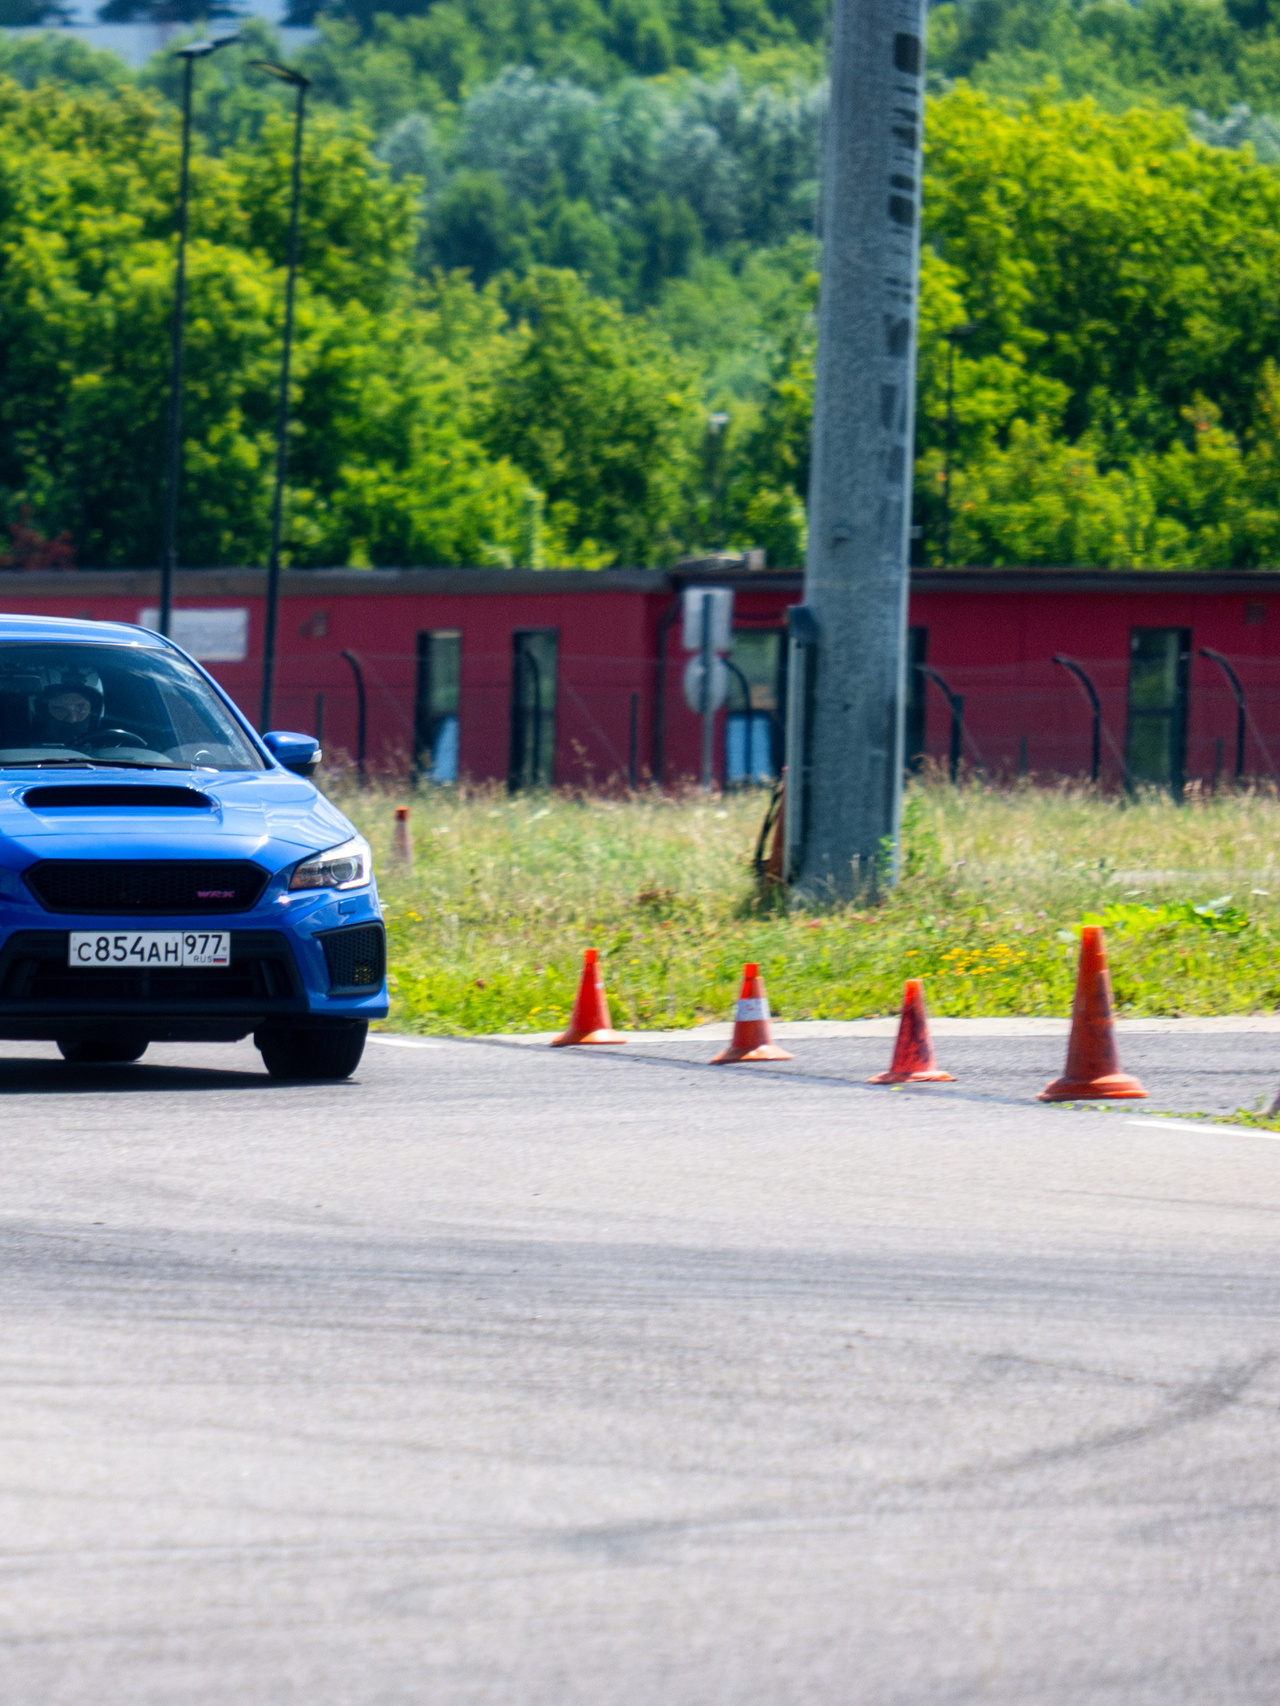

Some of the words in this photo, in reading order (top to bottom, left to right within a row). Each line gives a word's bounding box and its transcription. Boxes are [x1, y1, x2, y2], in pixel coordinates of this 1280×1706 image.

[77, 936, 179, 962] C854AH
[184, 934, 223, 955] 977
[193, 955, 213, 963] RUS
